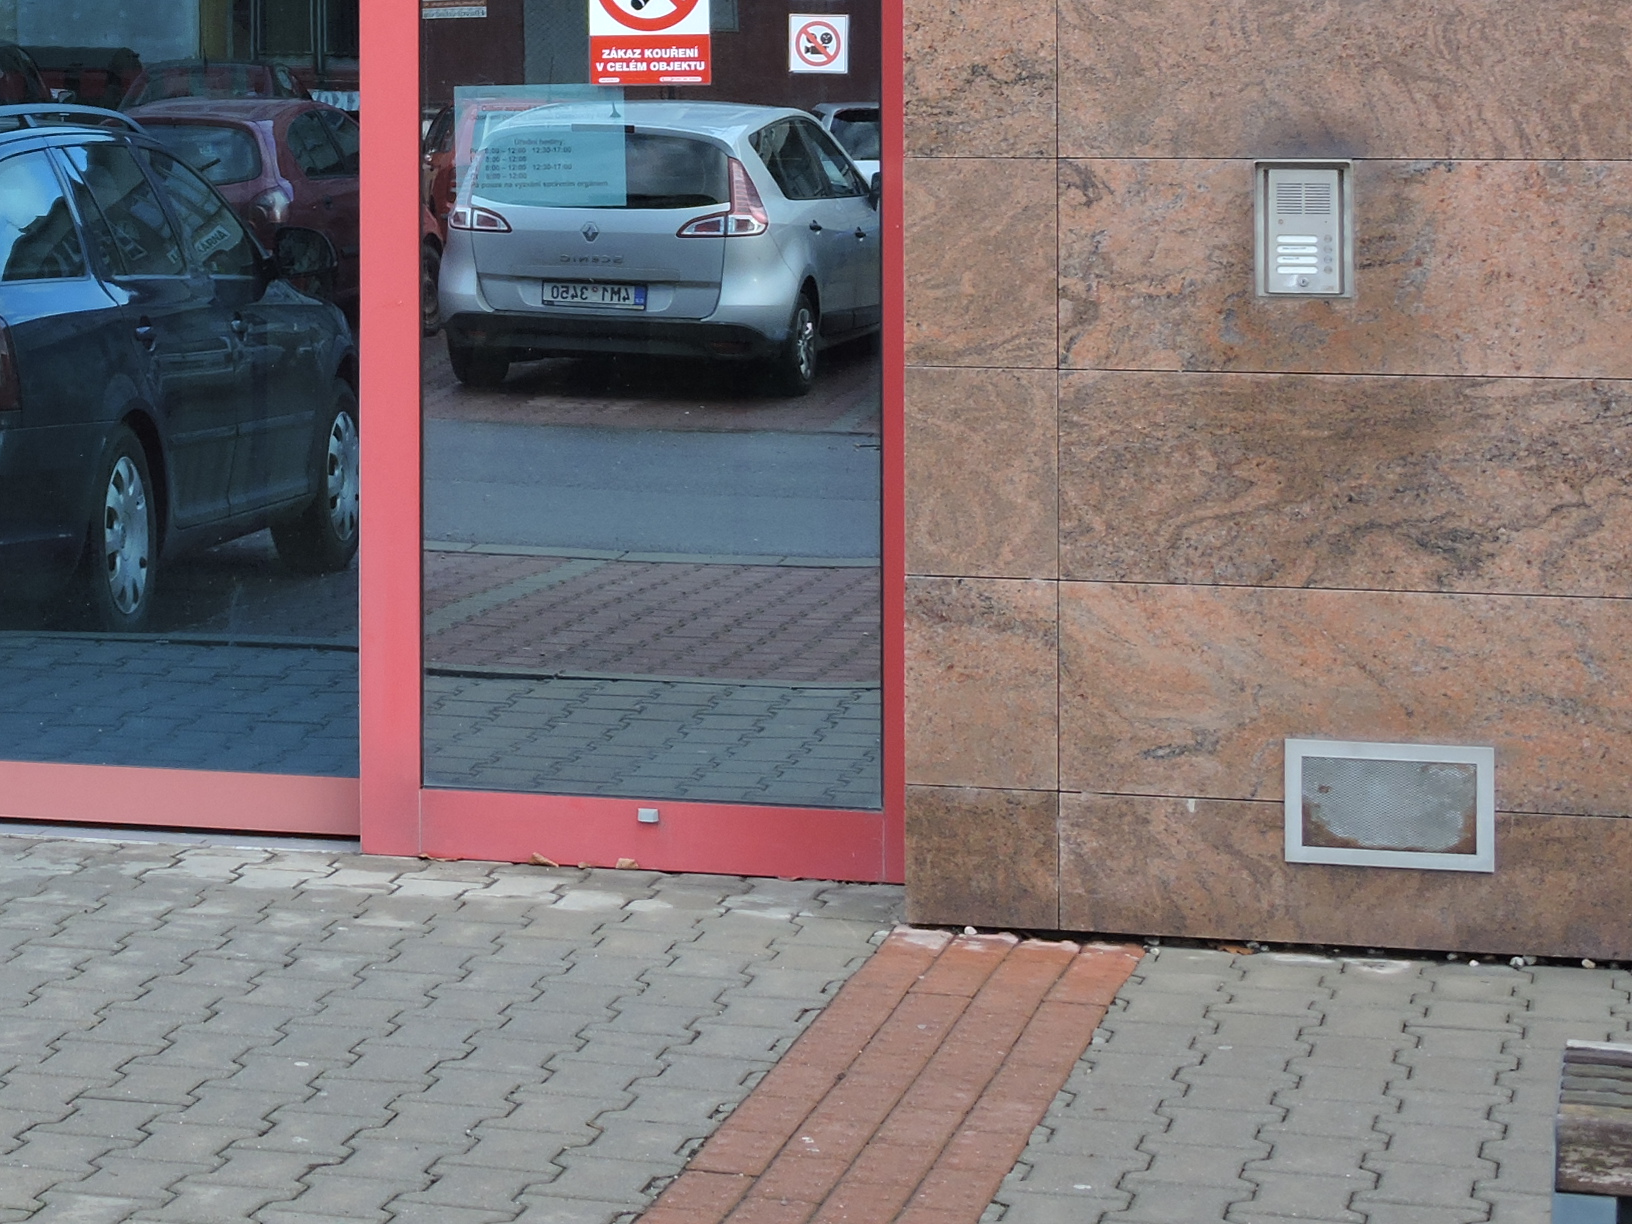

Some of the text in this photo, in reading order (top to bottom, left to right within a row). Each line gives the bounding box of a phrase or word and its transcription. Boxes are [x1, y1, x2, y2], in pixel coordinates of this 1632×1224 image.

[601, 45, 699, 59] ZÁKAZ KOUŘENÍ
[595, 58, 705, 72] V CELÉM OBJEKTU
